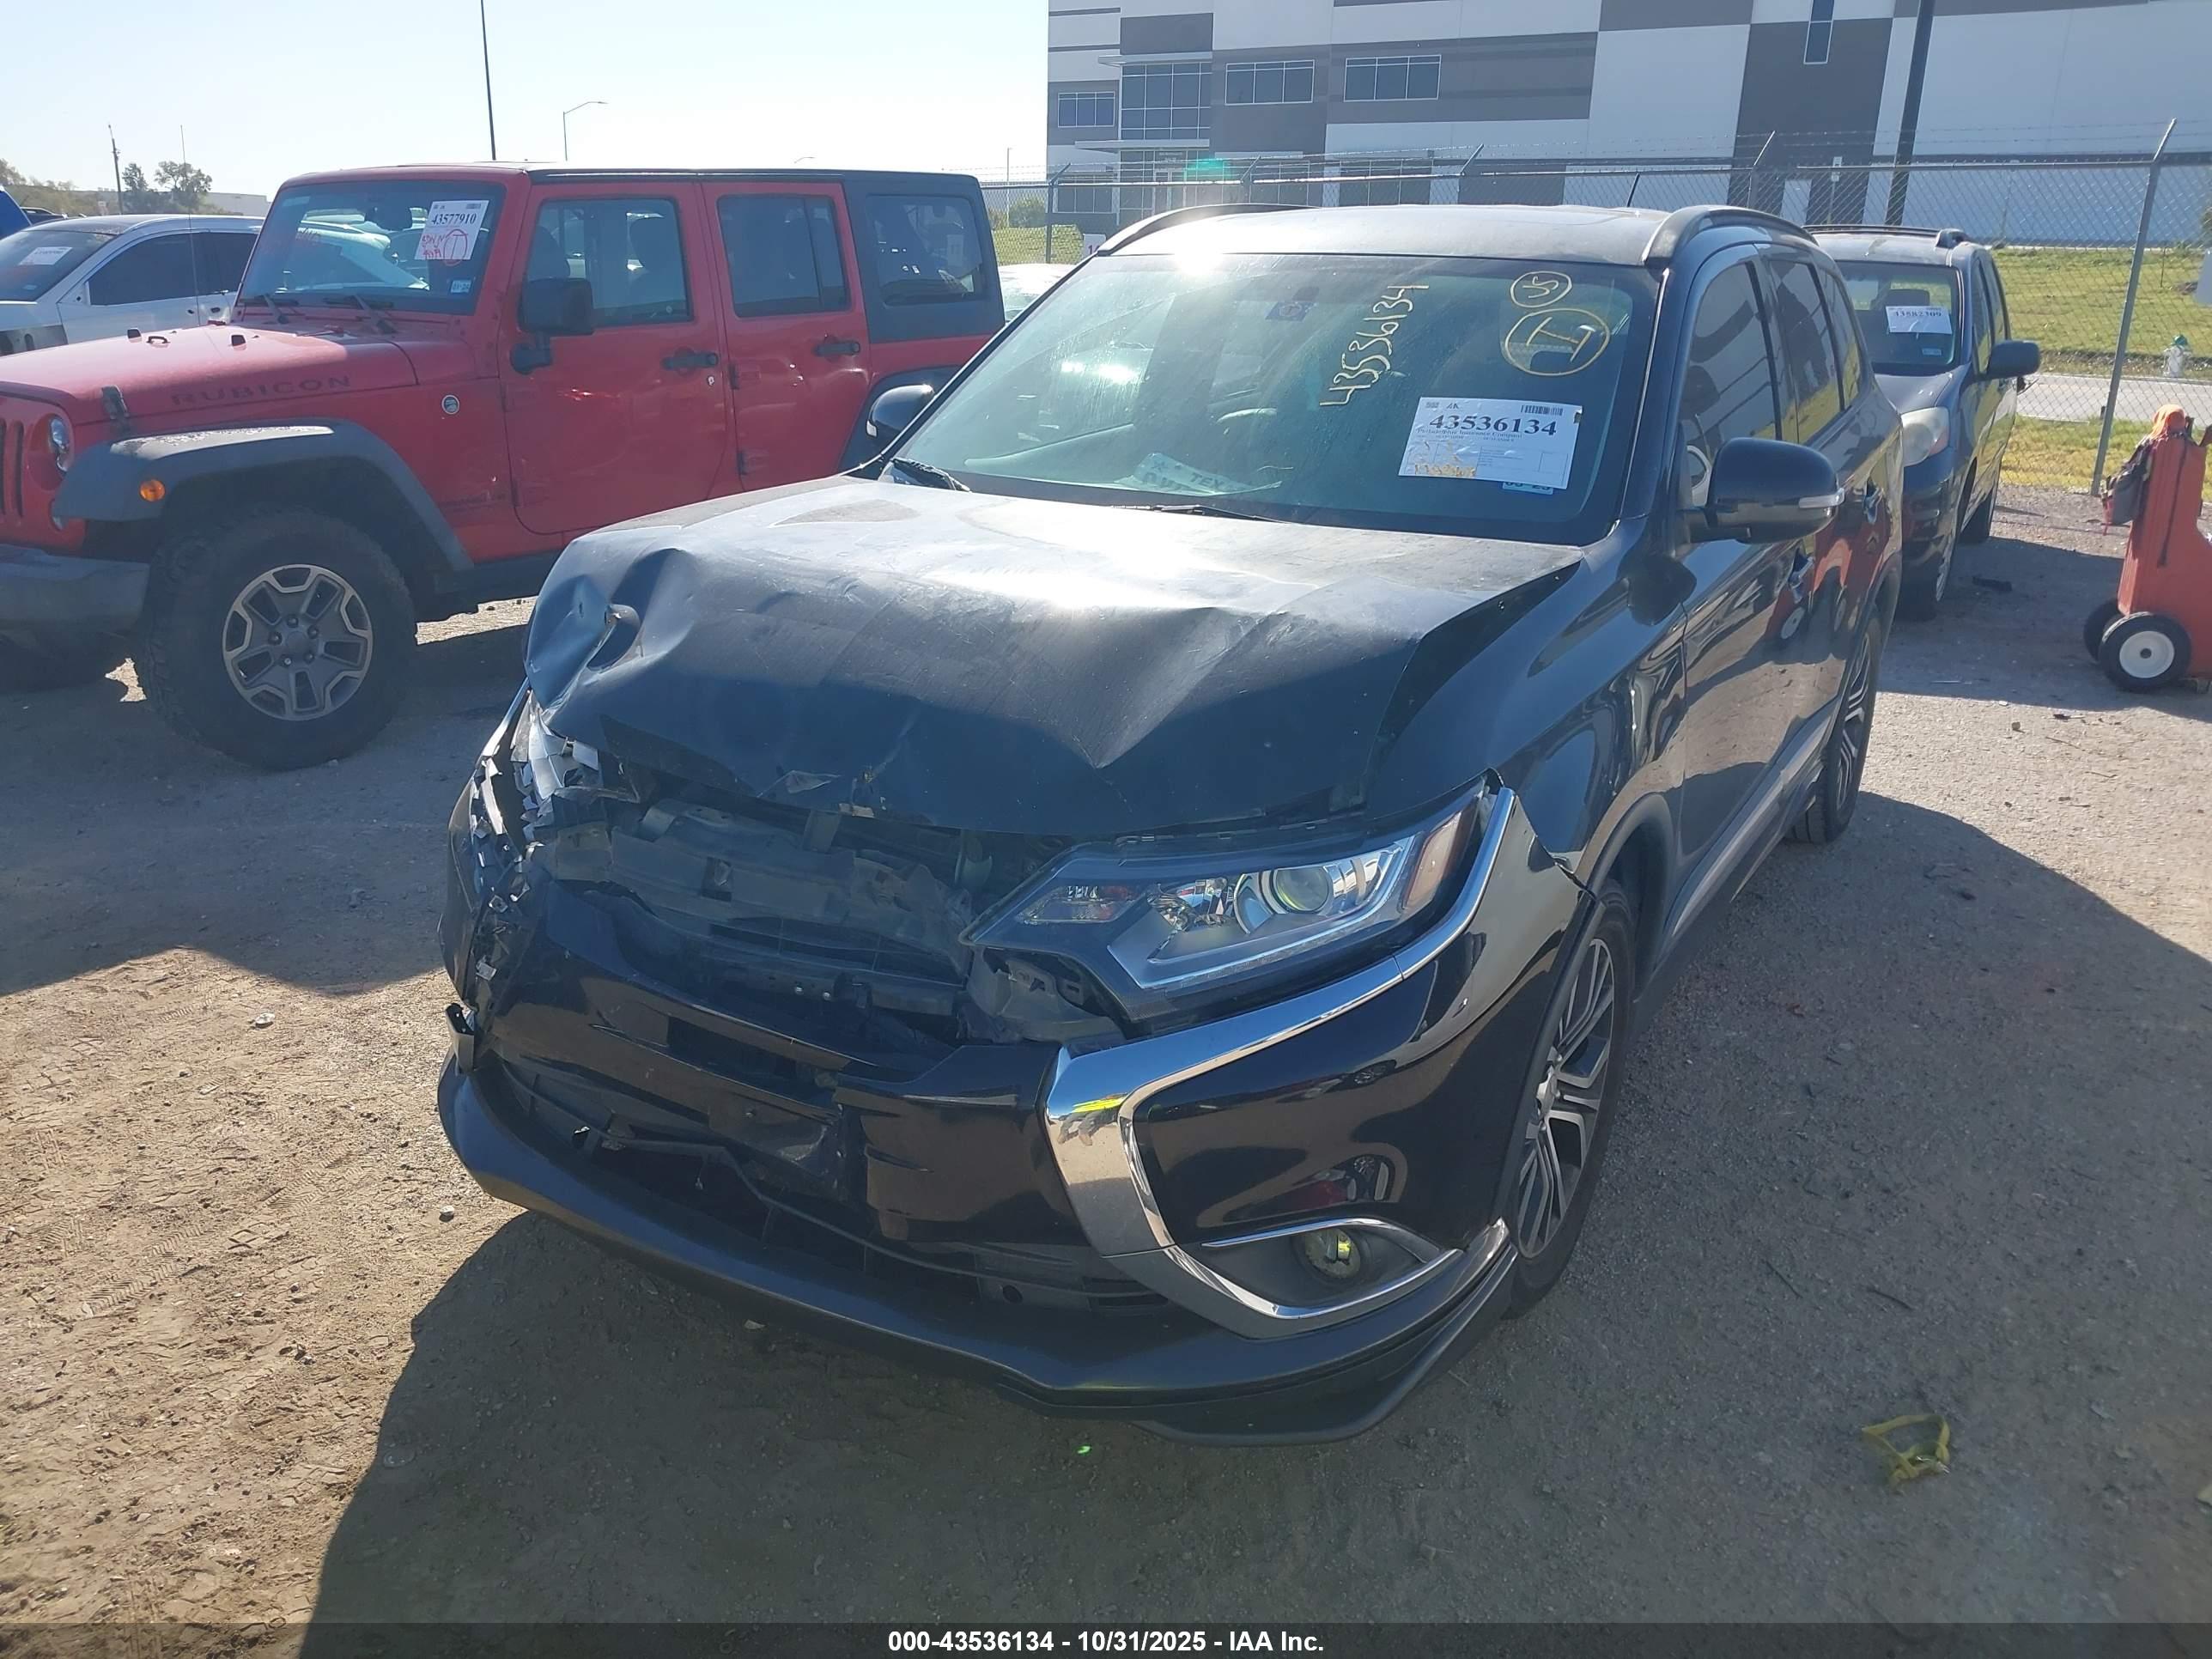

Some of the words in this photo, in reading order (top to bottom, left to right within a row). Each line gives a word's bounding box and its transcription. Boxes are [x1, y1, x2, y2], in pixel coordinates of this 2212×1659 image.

[432, 214, 477, 224] 43577910
[1320, 284, 1429, 406] 43536134
[172, 375, 350, 404] RUBICON
[1429, 414, 1558, 436] 43536134
